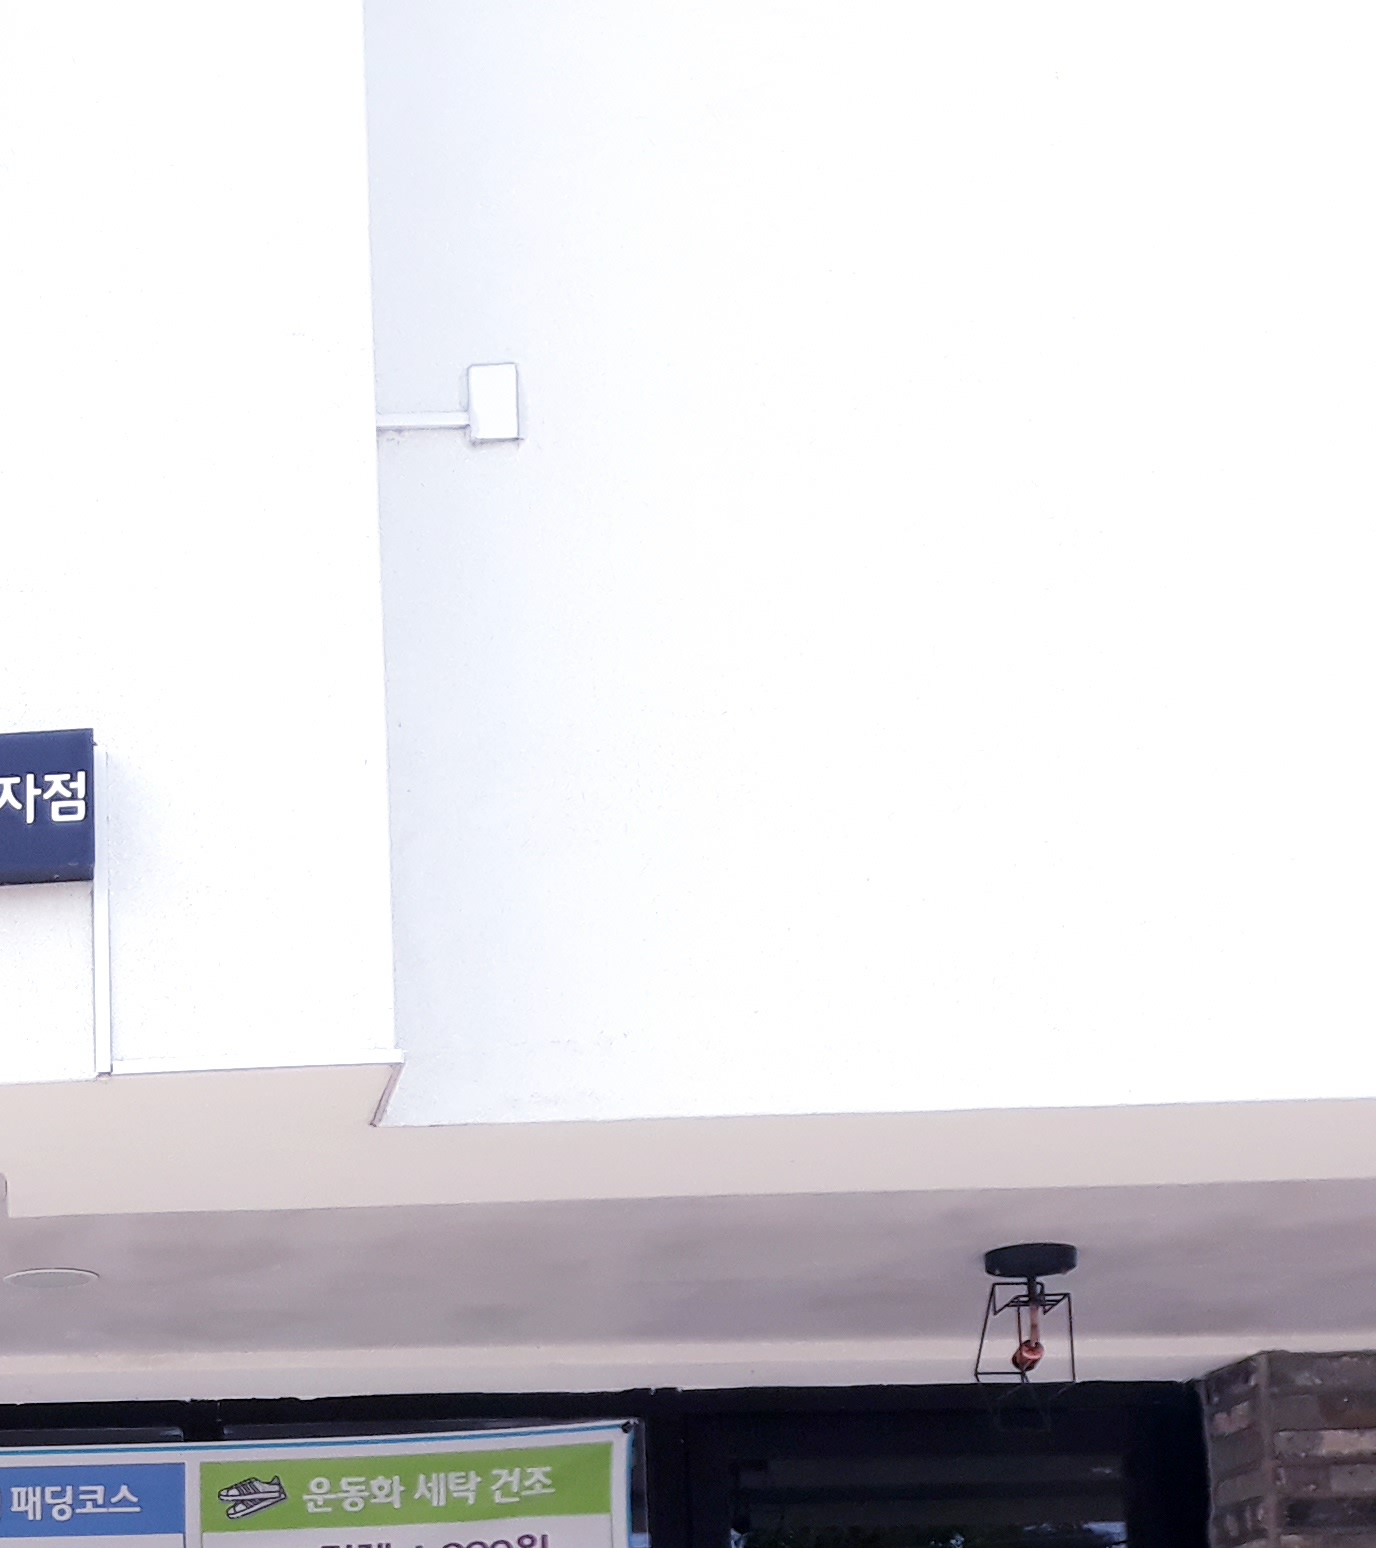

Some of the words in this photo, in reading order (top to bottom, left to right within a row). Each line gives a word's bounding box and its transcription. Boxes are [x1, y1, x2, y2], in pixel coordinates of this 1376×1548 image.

[10, 1484, 142, 1522] 패딩코스
[302, 1474, 406, 1514] 운동화
[413, 1470, 482, 1507] 세탁
[489, 1465, 556, 1503] 건조
